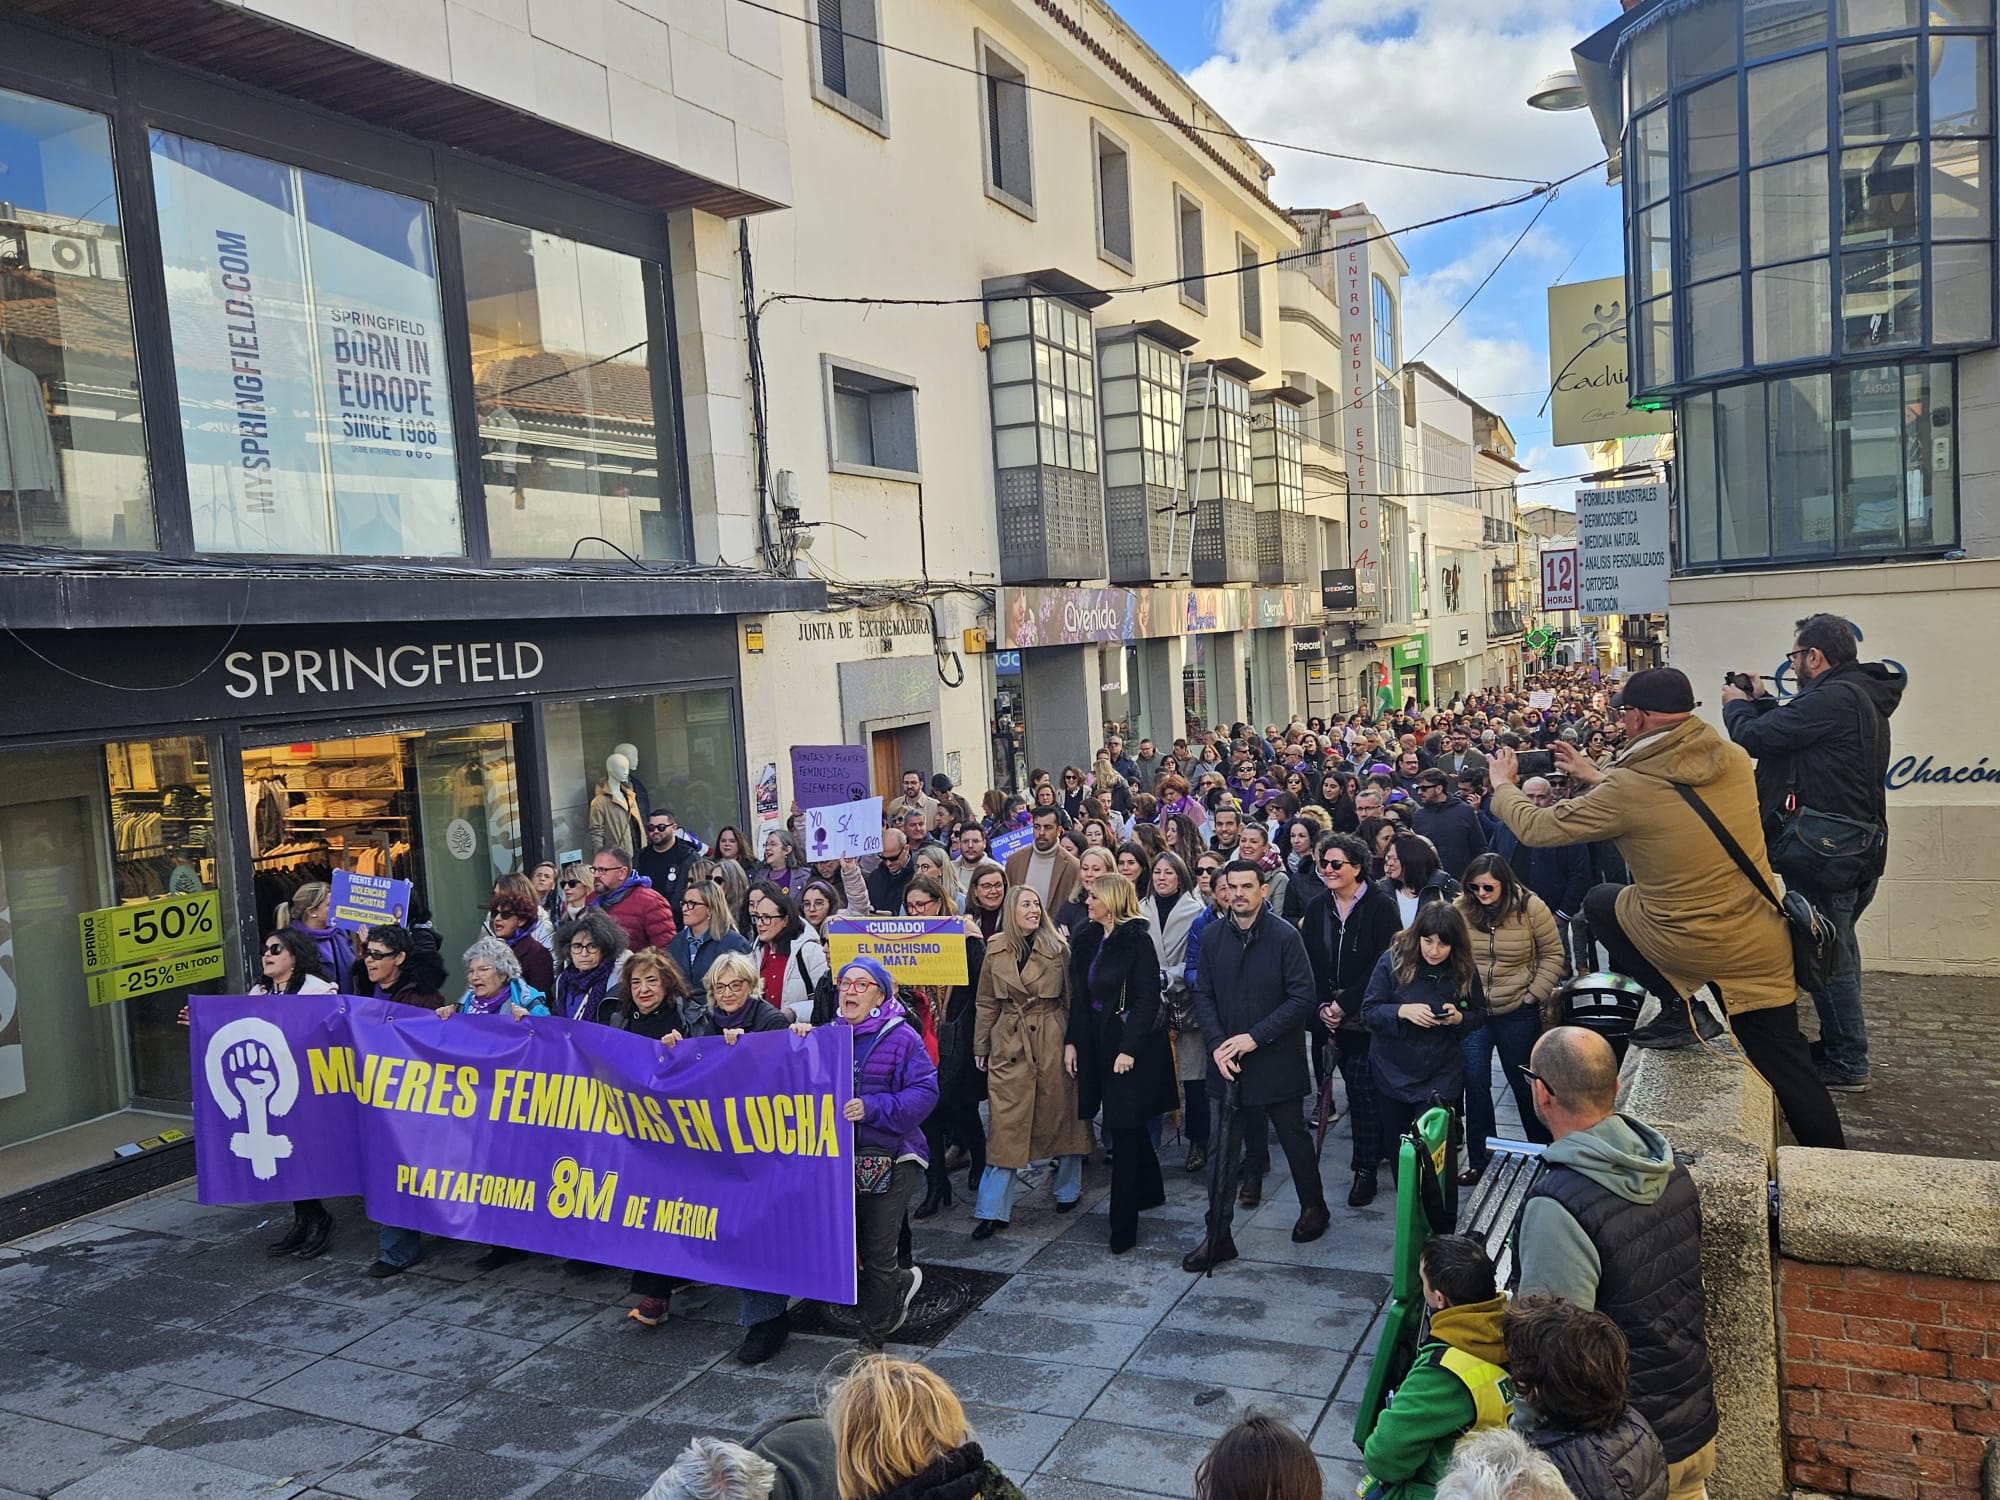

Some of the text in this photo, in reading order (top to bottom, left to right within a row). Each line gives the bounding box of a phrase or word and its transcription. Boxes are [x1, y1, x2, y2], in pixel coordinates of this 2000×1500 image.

[1349, 238, 1359, 316] CENTRO
[331, 309, 425, 336] SPRINGFIELD
[332, 327, 431, 376] BORN IN
[216, 229, 275, 513] MYSPRINGFIELD.COM
[1350, 333, 1363, 409] MÉDICO
[337, 369, 435, 417] EUROPE
[342, 412, 392, 441] SINCE
[1356, 428, 1369, 529] ESTÉTICO
[1583, 487, 1658, 507] FÓRMULAS MAGISTRALES
[1584, 508, 1638, 528] DERMOCOSMÉTICA
[1585, 531, 1641, 549] MEDICINA NATURAL
[1613, 551, 1665, 569] PERSONALIZADOS
[1547, 556, 1572, 592] 12
[1585, 576, 1619, 592] ORTOPEDIA
[1547, 595, 1573, 605] HORAS
[1586, 595, 1619, 612] NUTRICIÓN
[1064, 600, 1118, 633] Avenida
[798, 618, 931, 641] JUNTA DE EXTREMADURA
[224, 641, 544, 699] SPRINGFIELD
[794, 752, 866, 763] JUNTAS Y FUERTES
[798, 766, 850, 779] FEMINISTAS
[1884, 755, 2000, 790] Chacón
[801, 782, 845, 794] SIEMPRE
[809, 810, 822, 828] YO
[848, 833, 880, 851] TE CREO
[349, 875, 391, 889] FRENTE A LAS
[351, 885, 387, 898] VIOLENCIAS
[350, 895, 385, 908] MACHISTAS
[119, 900, 213, 945] -50%
[866, 922, 925, 933] ¡CUIDADO!
[84, 917, 97, 967] SPRING
[98, 913, 111, 966] SPECIAL
[858, 943, 872, 954] EL
[874, 943, 940, 954] MACHISMO
[883, 955, 918, 966] MATA
[119, 964, 174, 993] -25%
[175, 960, 189, 972] EN
[307, 1046, 840, 1158] MUJERES FEMINISTAS EN LUCHA
[396, 1156, 719, 1242] PLATAFORMA 8M DE MÉRIDA
